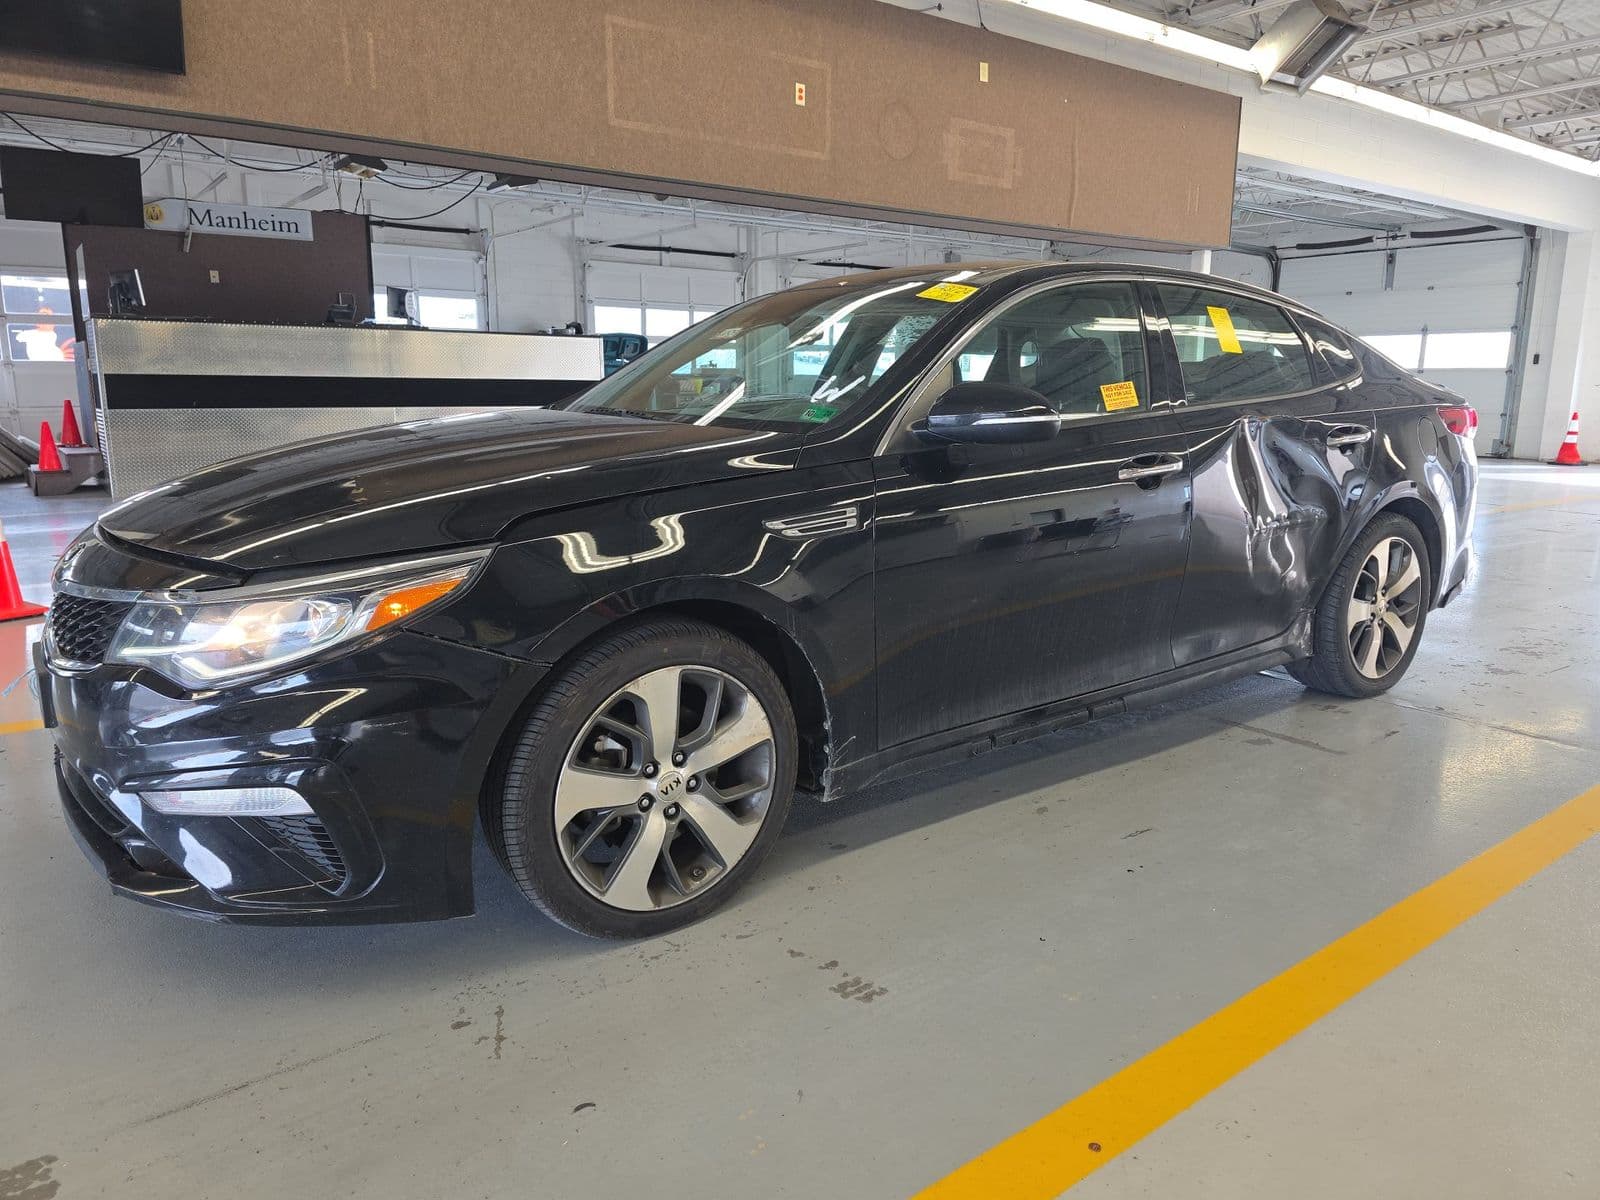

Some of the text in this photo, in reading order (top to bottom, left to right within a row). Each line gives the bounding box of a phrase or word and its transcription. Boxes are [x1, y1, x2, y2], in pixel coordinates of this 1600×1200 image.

[187, 207, 300, 234] Manheim
[1113, 383, 1132, 391] VEHICLE
[660, 777, 682, 796] KIA
